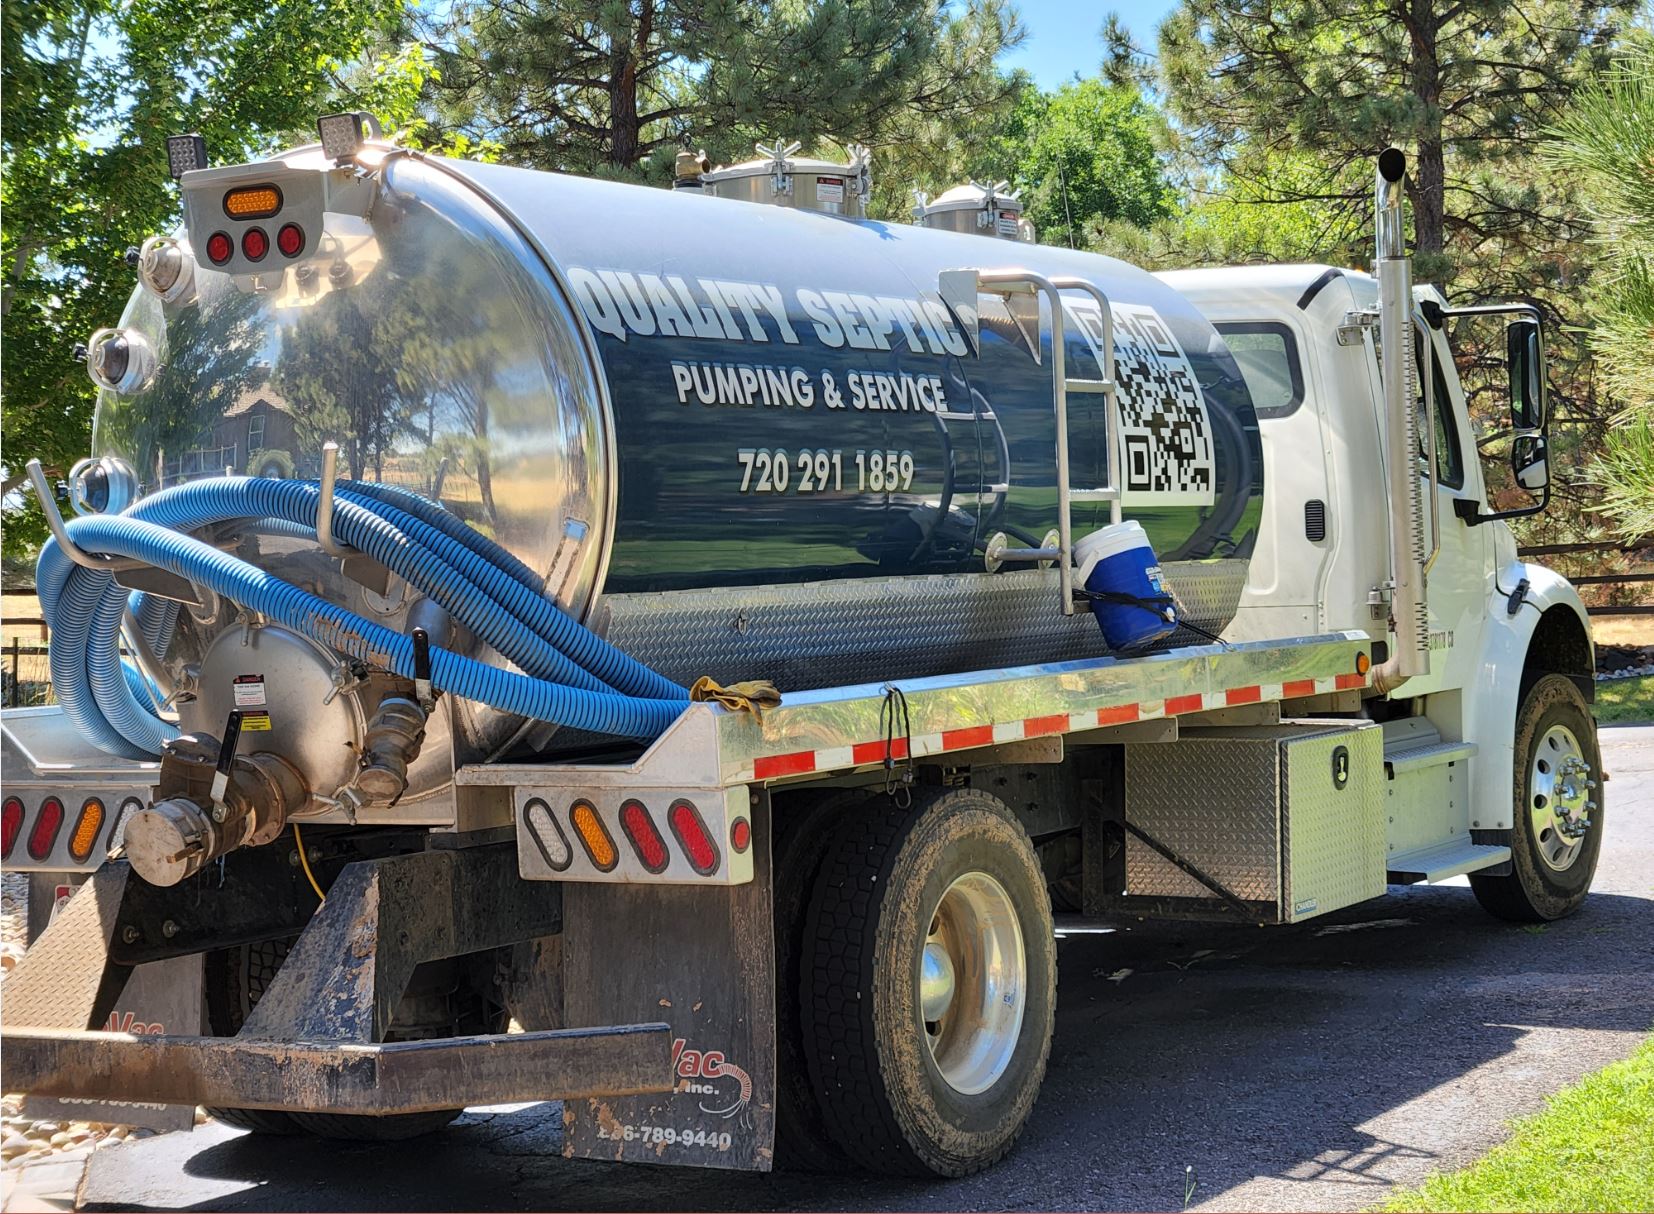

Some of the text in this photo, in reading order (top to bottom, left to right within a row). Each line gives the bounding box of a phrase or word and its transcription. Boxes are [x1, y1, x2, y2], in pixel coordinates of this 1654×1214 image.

[567, 267, 969, 357] QUALITY SEPTIC
[671, 360, 949, 413] PUMPING & SERVICE
[737, 448, 915, 492] 720 291 1859
[103, 1011, 164, 1035] Vac
[685, 1081, 720, 1095] Inc.
[598, 1124, 732, 1150] 6-789-9440
